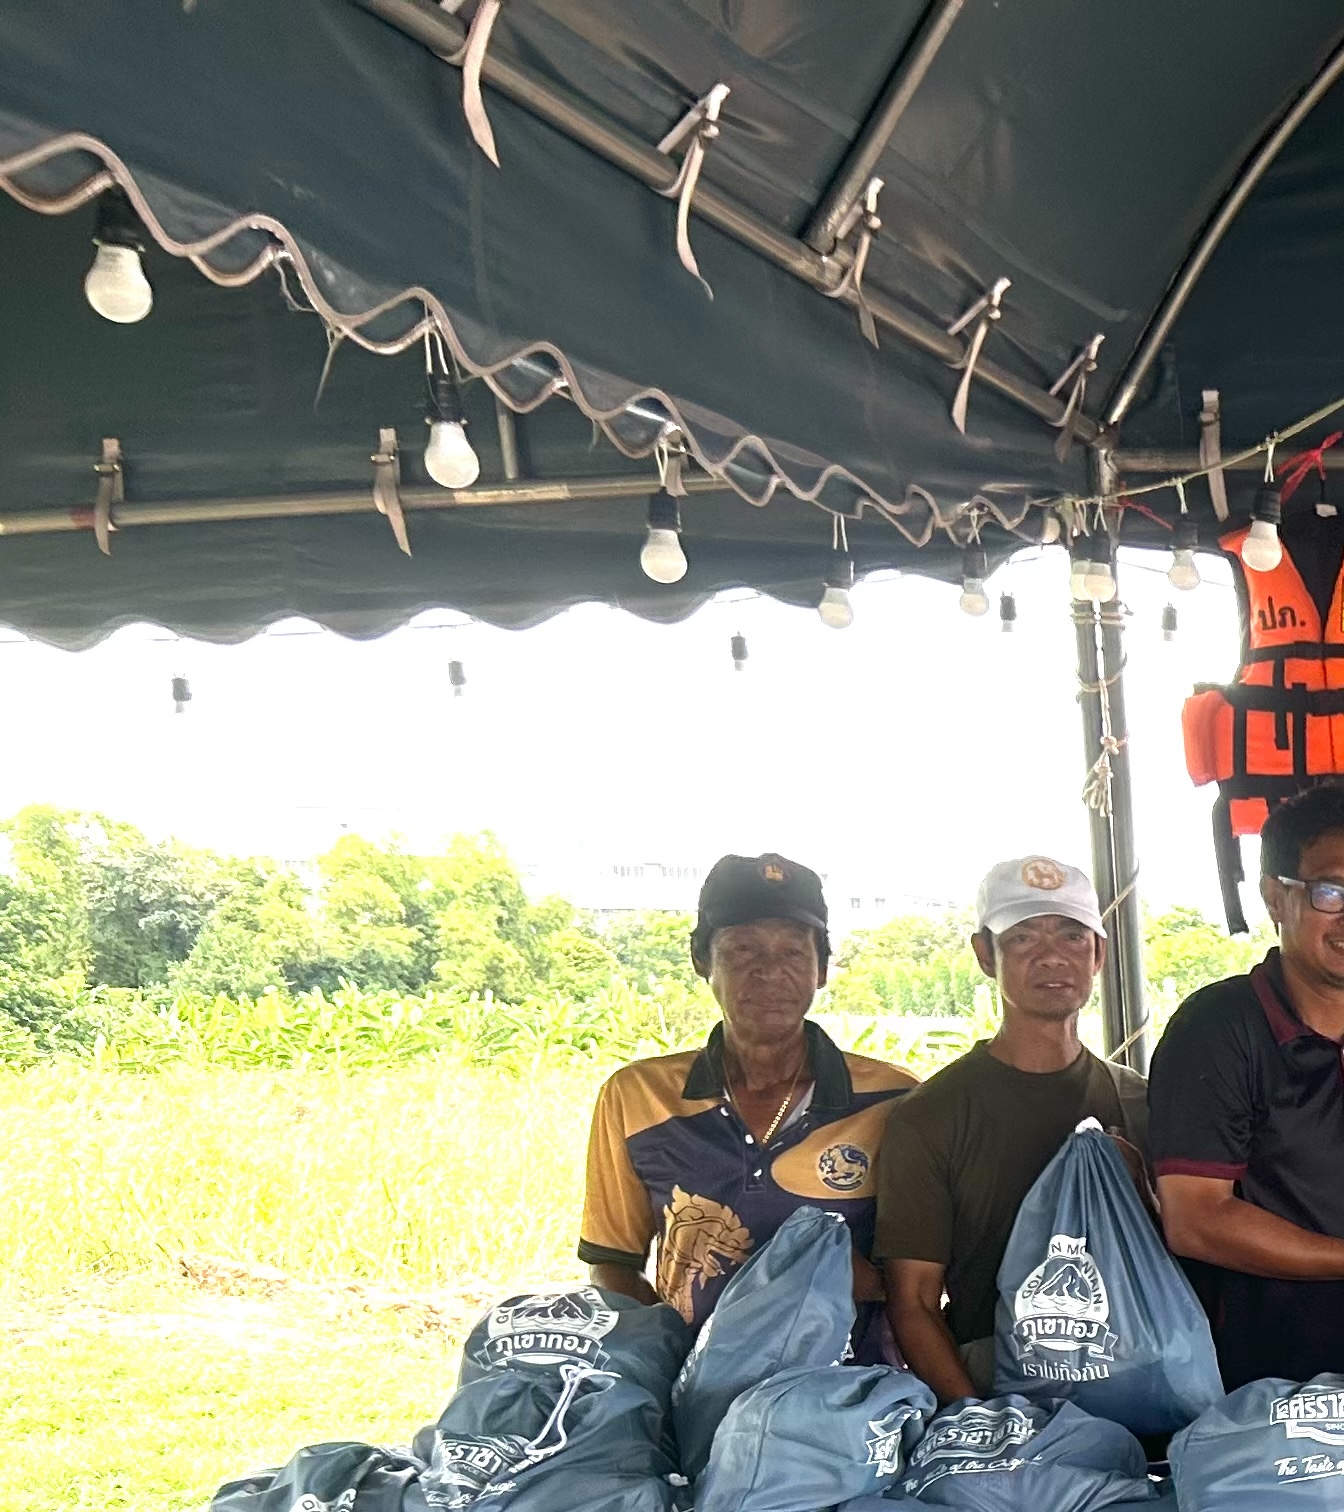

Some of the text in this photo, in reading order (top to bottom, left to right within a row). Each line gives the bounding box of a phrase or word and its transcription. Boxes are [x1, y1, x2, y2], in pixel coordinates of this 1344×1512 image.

[1257, 598, 1306, 630] ปภ.
[496, 1333, 592, 1357] ภูเขาทอง
[1023, 1358, 1110, 1382] เราไม่ทิ้งกัน
[1274, 1457, 1298, 1477] The
[1301, 1454, 1335, 1475] Taste
